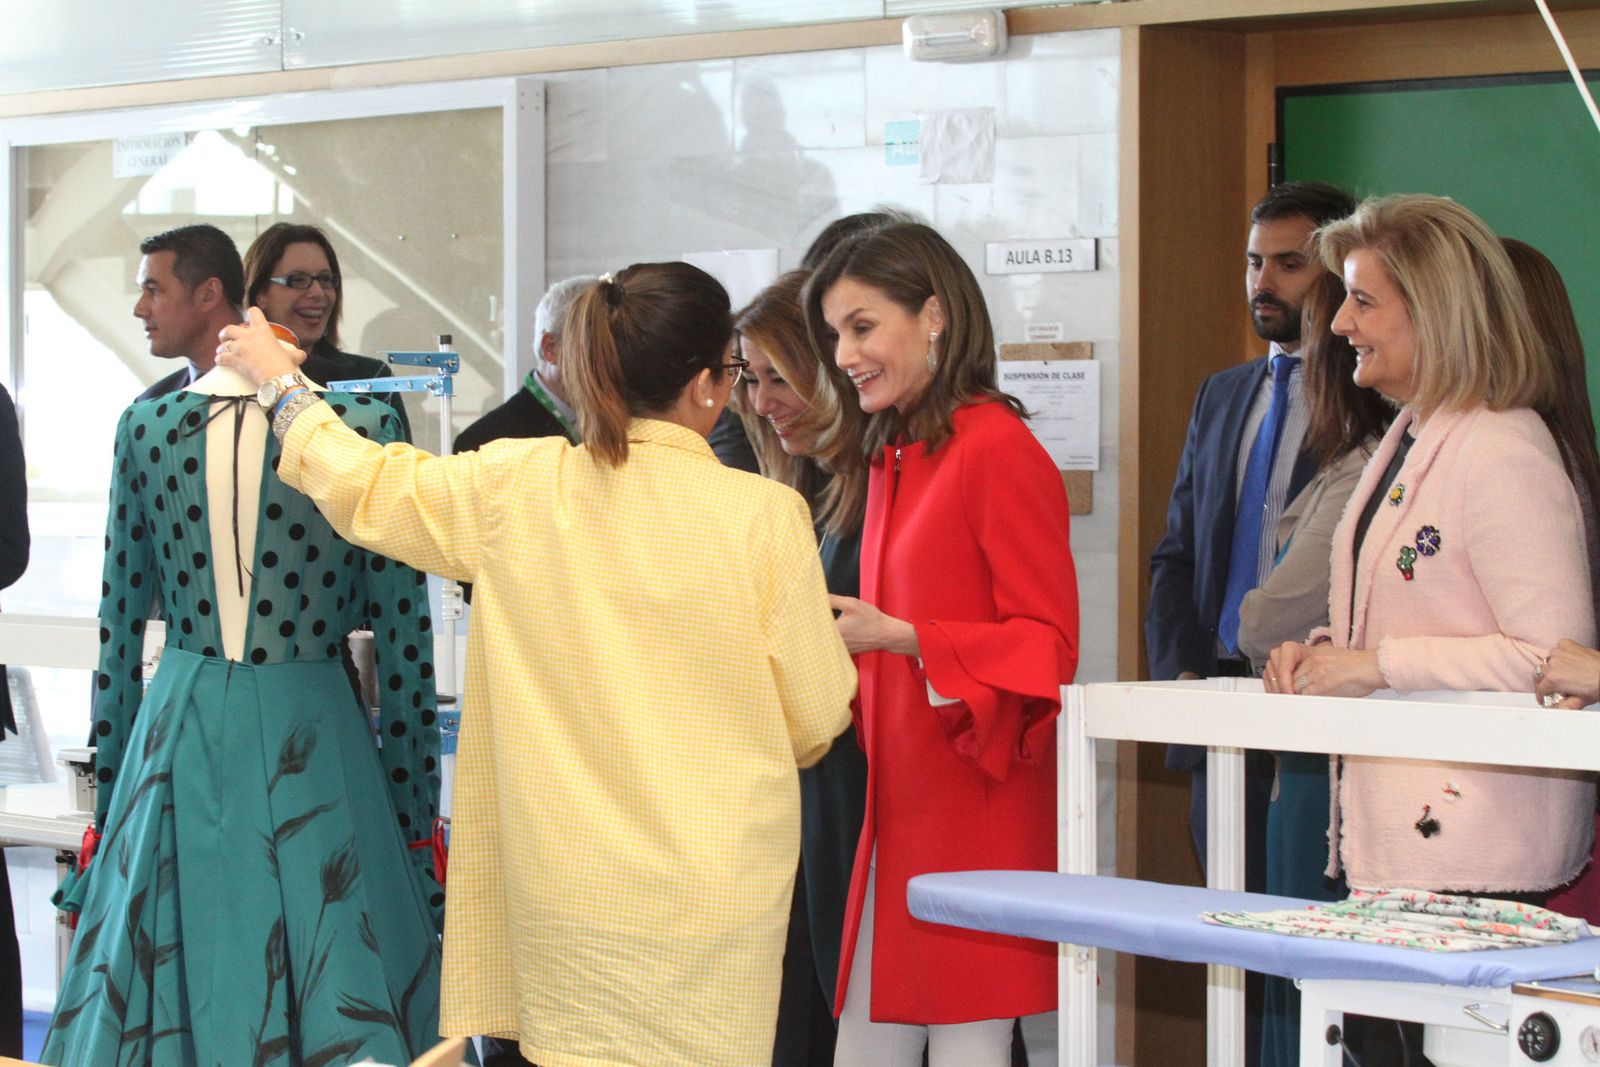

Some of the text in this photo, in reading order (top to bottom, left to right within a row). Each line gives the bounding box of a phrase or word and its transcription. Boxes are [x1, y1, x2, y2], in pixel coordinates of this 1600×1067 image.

[1006, 248, 1073, 265] AULA B.13
[1051, 372, 1060, 380] DE
[1062, 371, 1086, 380] CLASE
